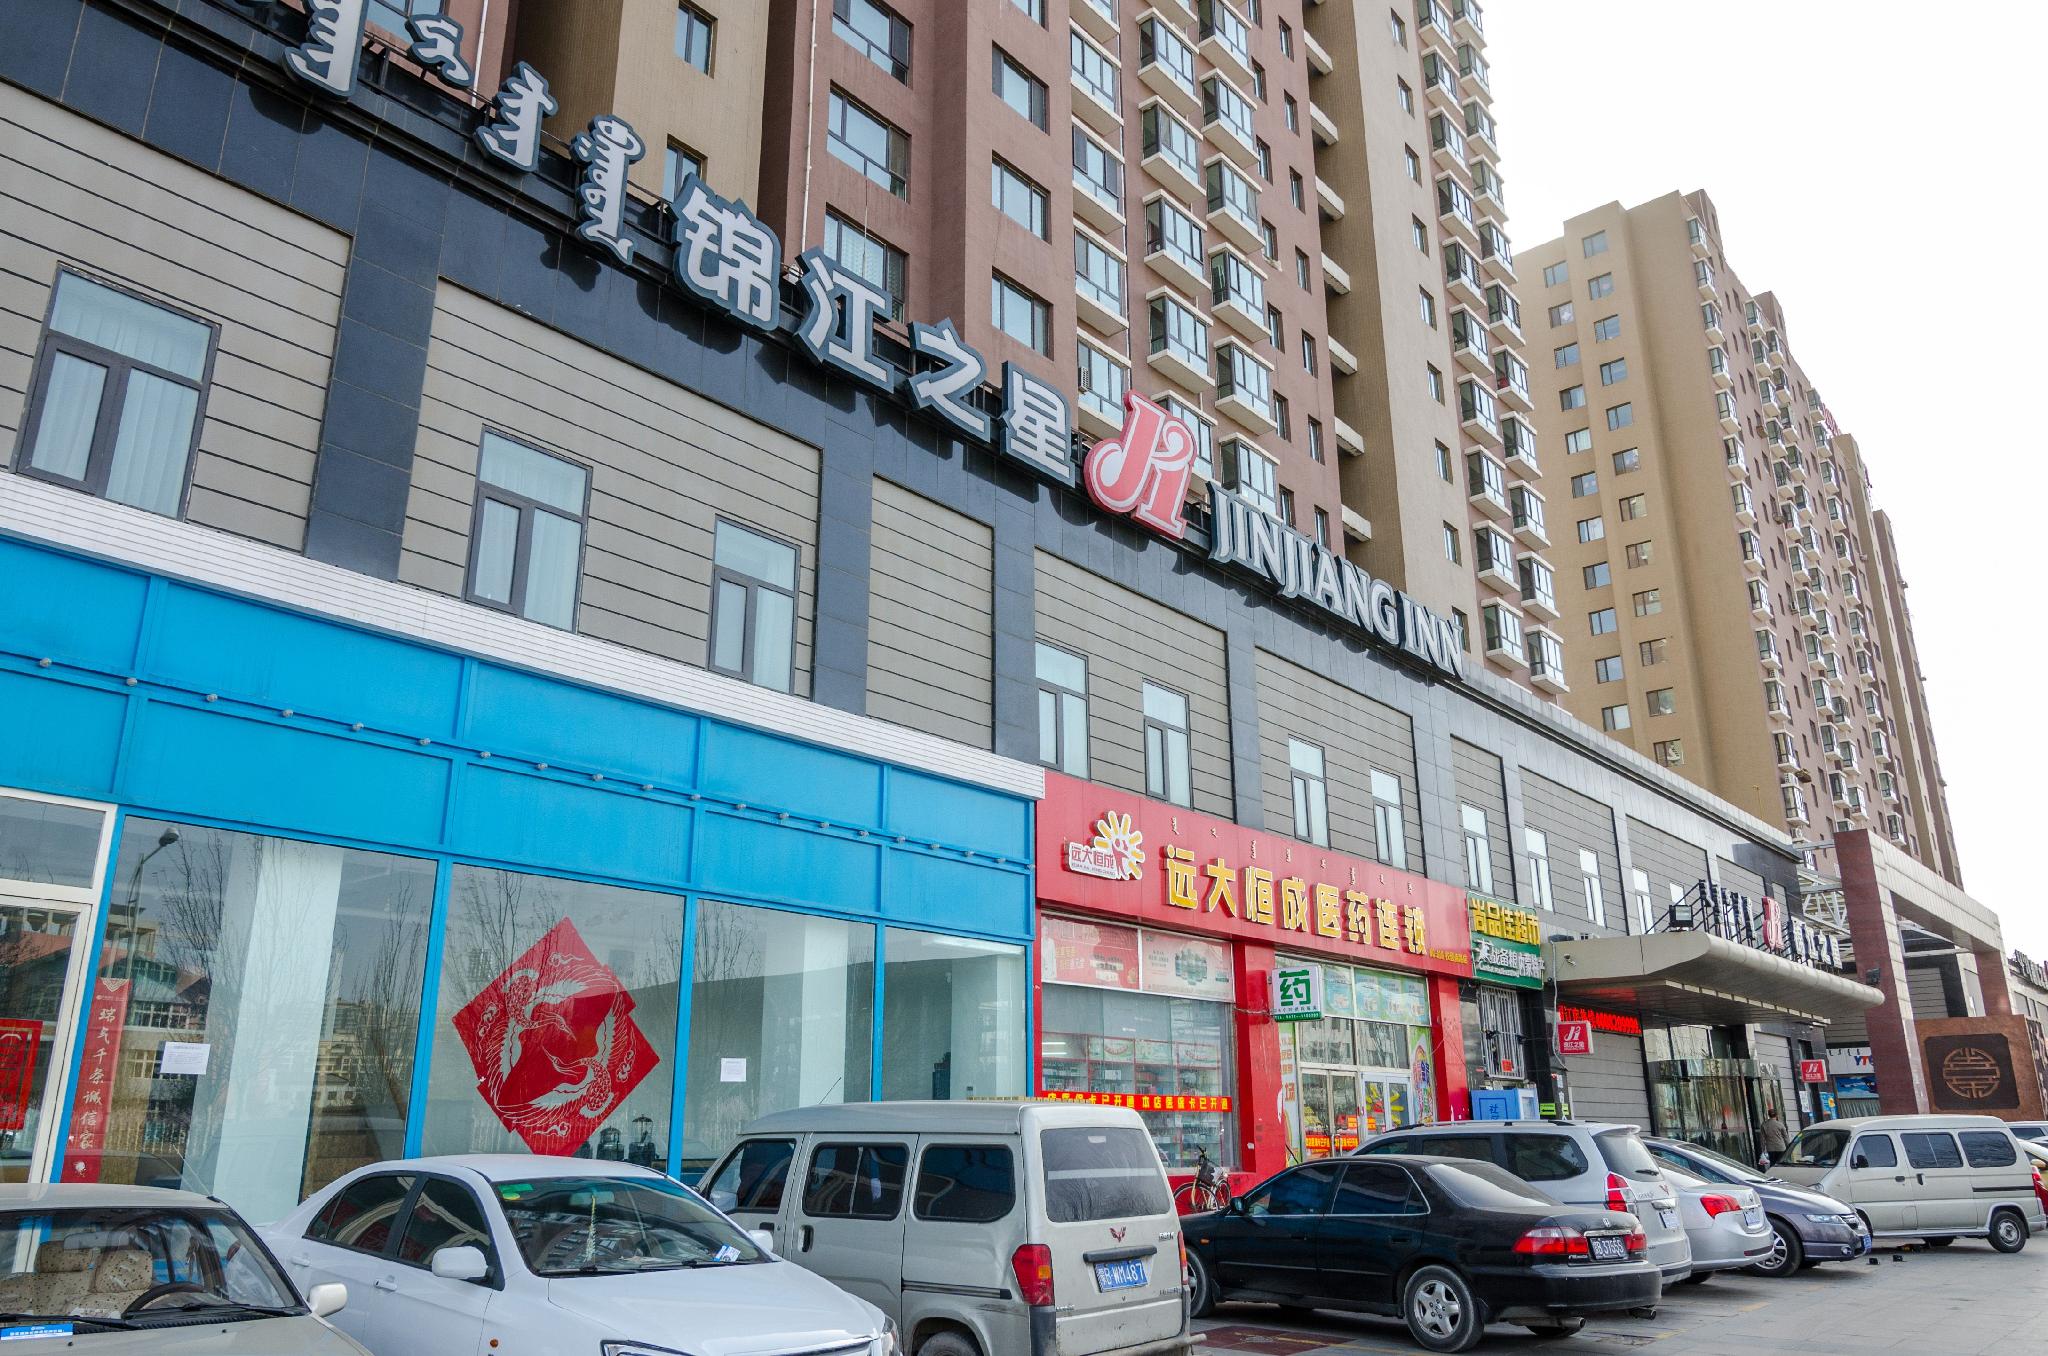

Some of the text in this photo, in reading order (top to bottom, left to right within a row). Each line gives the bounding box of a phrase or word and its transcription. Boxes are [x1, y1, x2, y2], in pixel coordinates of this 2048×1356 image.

[676, 184, 1073, 485] 锦江之星
[1211, 487, 1464, 679] JINJIANG INN
[1071, 845, 1114, 868] 远大恒成
[1165, 844, 1427, 955] 远大恒成医药连锁
[1471, 897, 1540, 945] 尚品佳超市
[1278, 969, 1311, 1007] 药
[1142, 1097, 1228, 1110] 本店医保卡已开通
